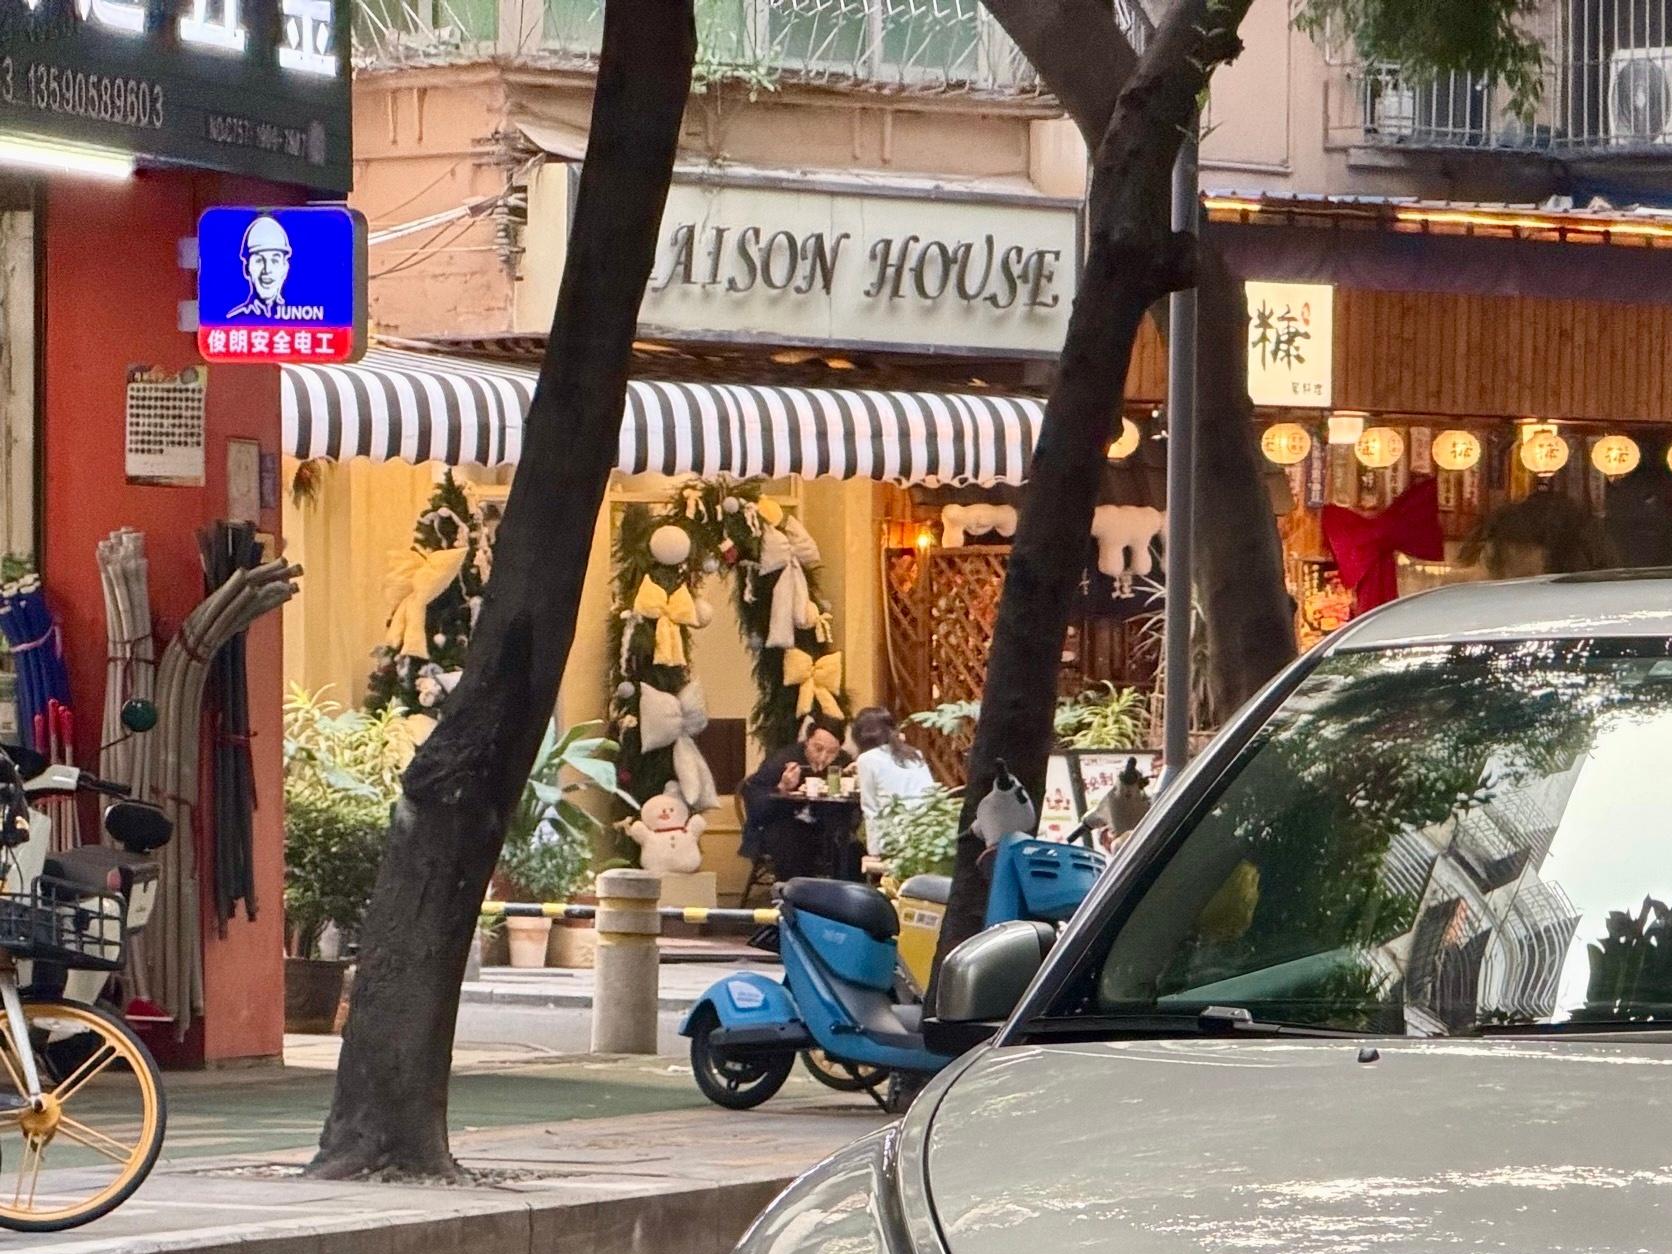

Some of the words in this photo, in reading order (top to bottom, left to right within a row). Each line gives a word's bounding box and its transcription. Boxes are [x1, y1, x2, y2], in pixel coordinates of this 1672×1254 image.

[650, 222, 851, 296] AISON
[863, 234, 1062, 309] HOUSE
[274, 305, 324, 320] JUNON
[207, 329, 335, 354] 俊朗安全电工
